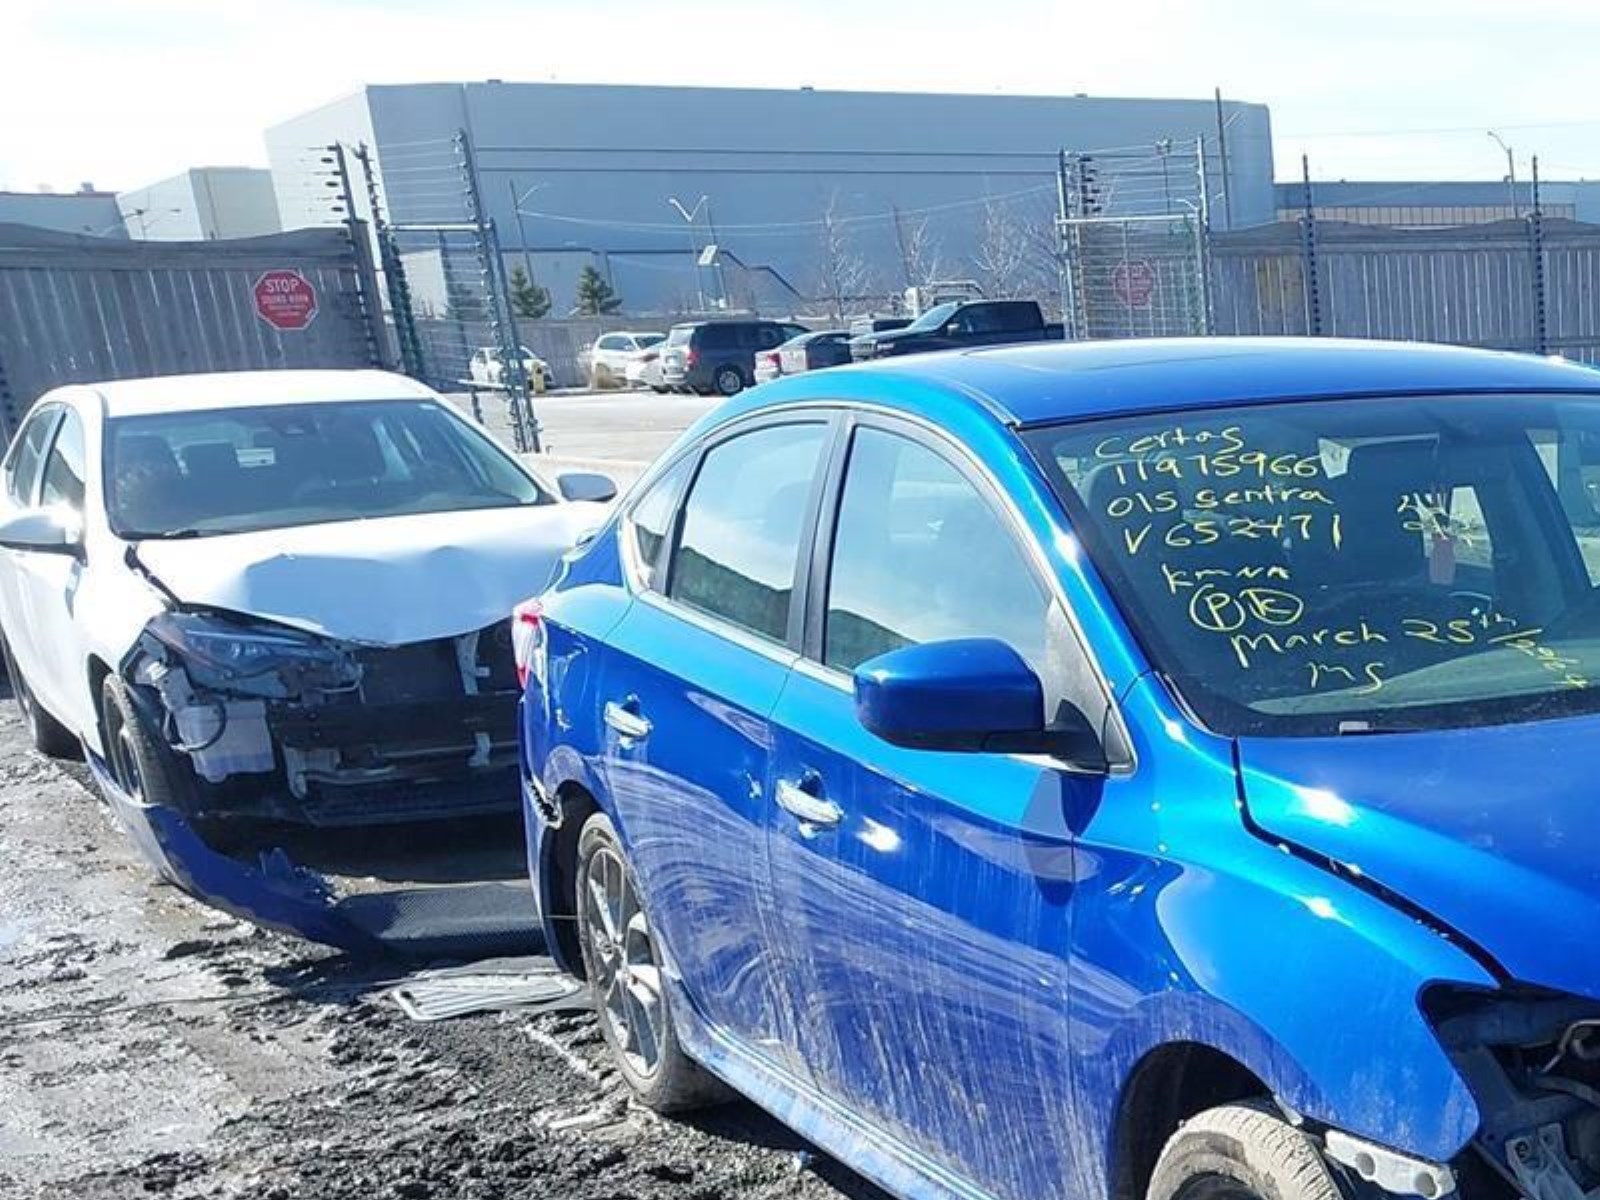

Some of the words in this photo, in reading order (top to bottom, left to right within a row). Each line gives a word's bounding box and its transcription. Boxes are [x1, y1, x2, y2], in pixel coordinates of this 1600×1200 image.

[265, 278, 301, 292] STOP
[1115, 452, 1322, 485] 11975966
[1124, 523, 1152, 554] V
[1231, 621, 1388, 668] March
